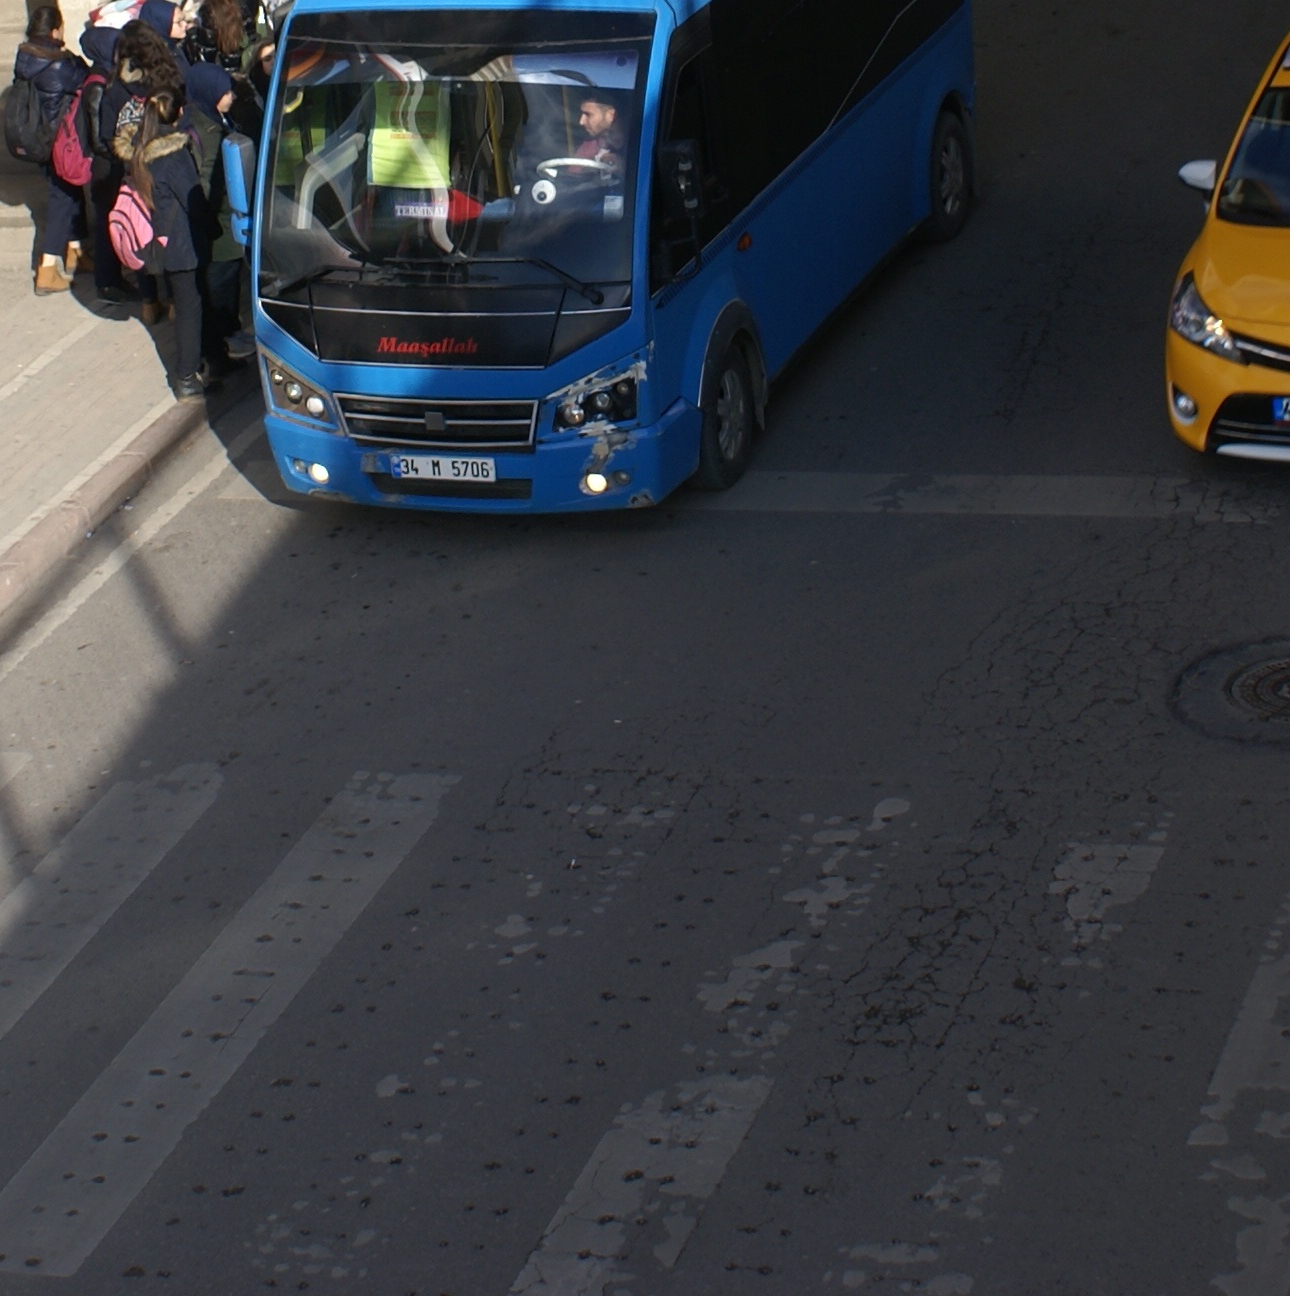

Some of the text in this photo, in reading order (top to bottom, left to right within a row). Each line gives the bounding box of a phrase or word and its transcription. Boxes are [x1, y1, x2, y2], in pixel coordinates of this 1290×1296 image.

[376, 337, 479, 358] Maaşallah
[401, 459, 490, 479] 34 M 5706
